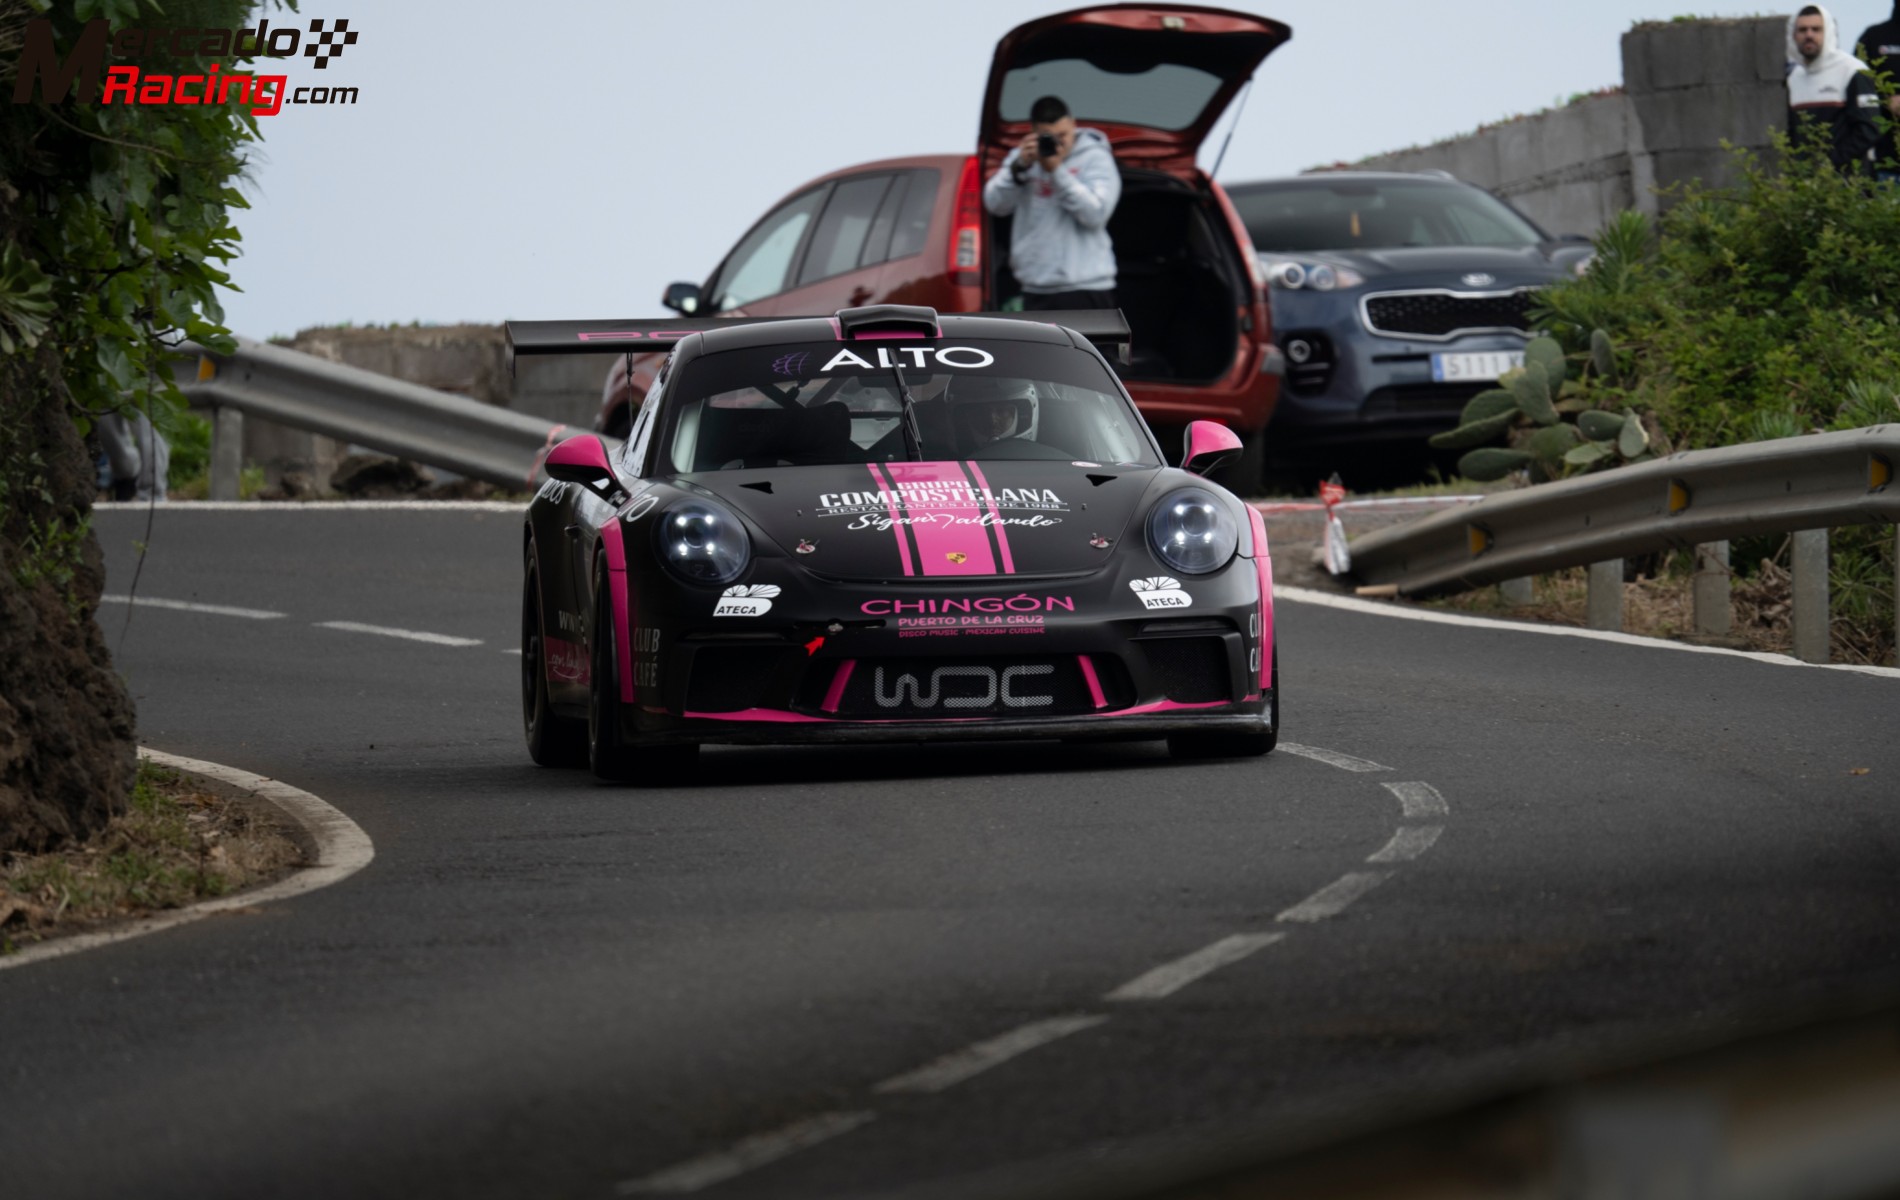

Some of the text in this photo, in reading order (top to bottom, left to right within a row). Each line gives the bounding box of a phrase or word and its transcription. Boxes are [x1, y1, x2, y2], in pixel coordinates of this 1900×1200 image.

[820, 346, 994, 372] ALTO
[820, 488, 1062, 508] COMPOSTELANA
[963, 501, 1018, 509] DESDE
[861, 593, 1075, 615] CHINGÓN
[1147, 597, 1184, 607] ATECA
[716, 605, 757, 615] ATECA
[898, 615, 1045, 627] PUERTO DE LA CRUZ
[898, 627, 1045, 638] DISCO MUSIC MEXICAN CUISINE
[633, 627, 661, 653] CLUB
